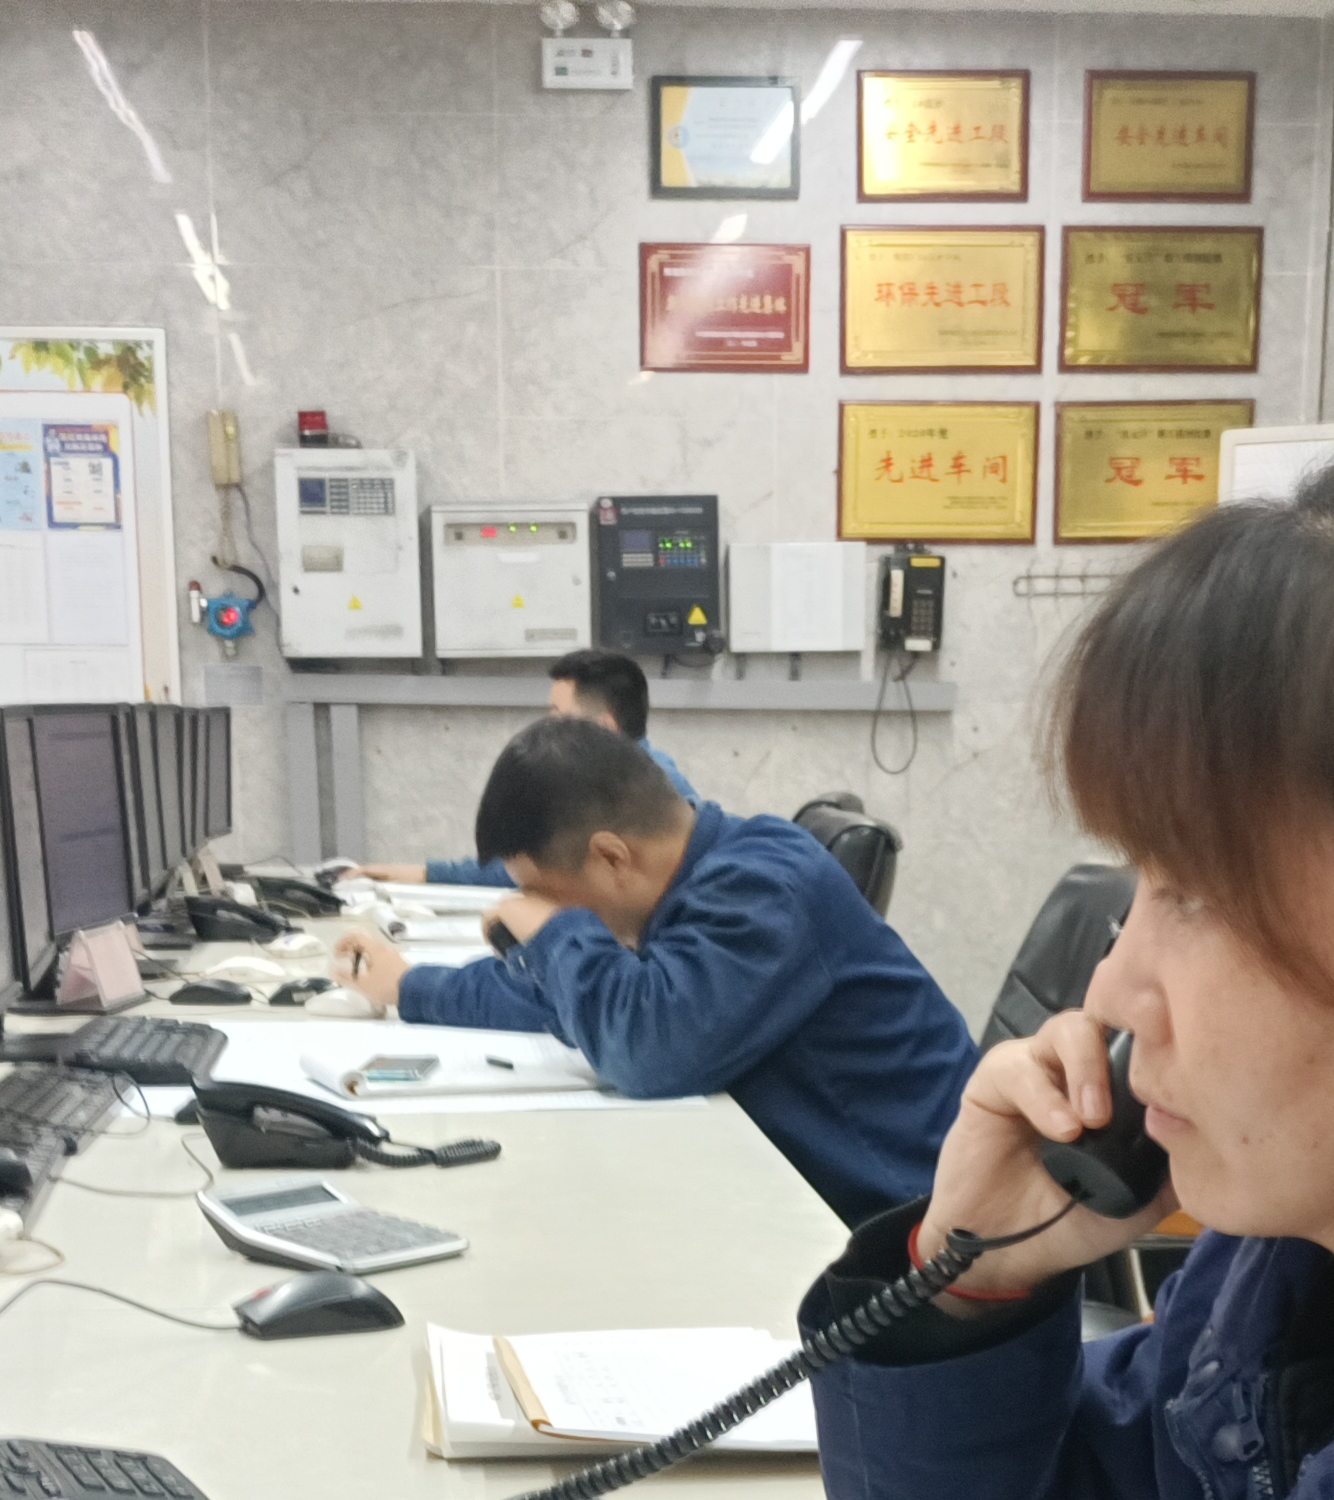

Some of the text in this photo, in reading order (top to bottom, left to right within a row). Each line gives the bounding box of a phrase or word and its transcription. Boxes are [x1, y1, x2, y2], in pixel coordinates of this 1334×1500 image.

[886, 121, 1009, 144] 全先进工段
[874, 281, 1011, 308] 环保先进工段
[1106, 282, 1216, 315] 冠军
[874, 450, 1008, 485] 先进车间
[1105, 456, 1205, 487] 冠军
